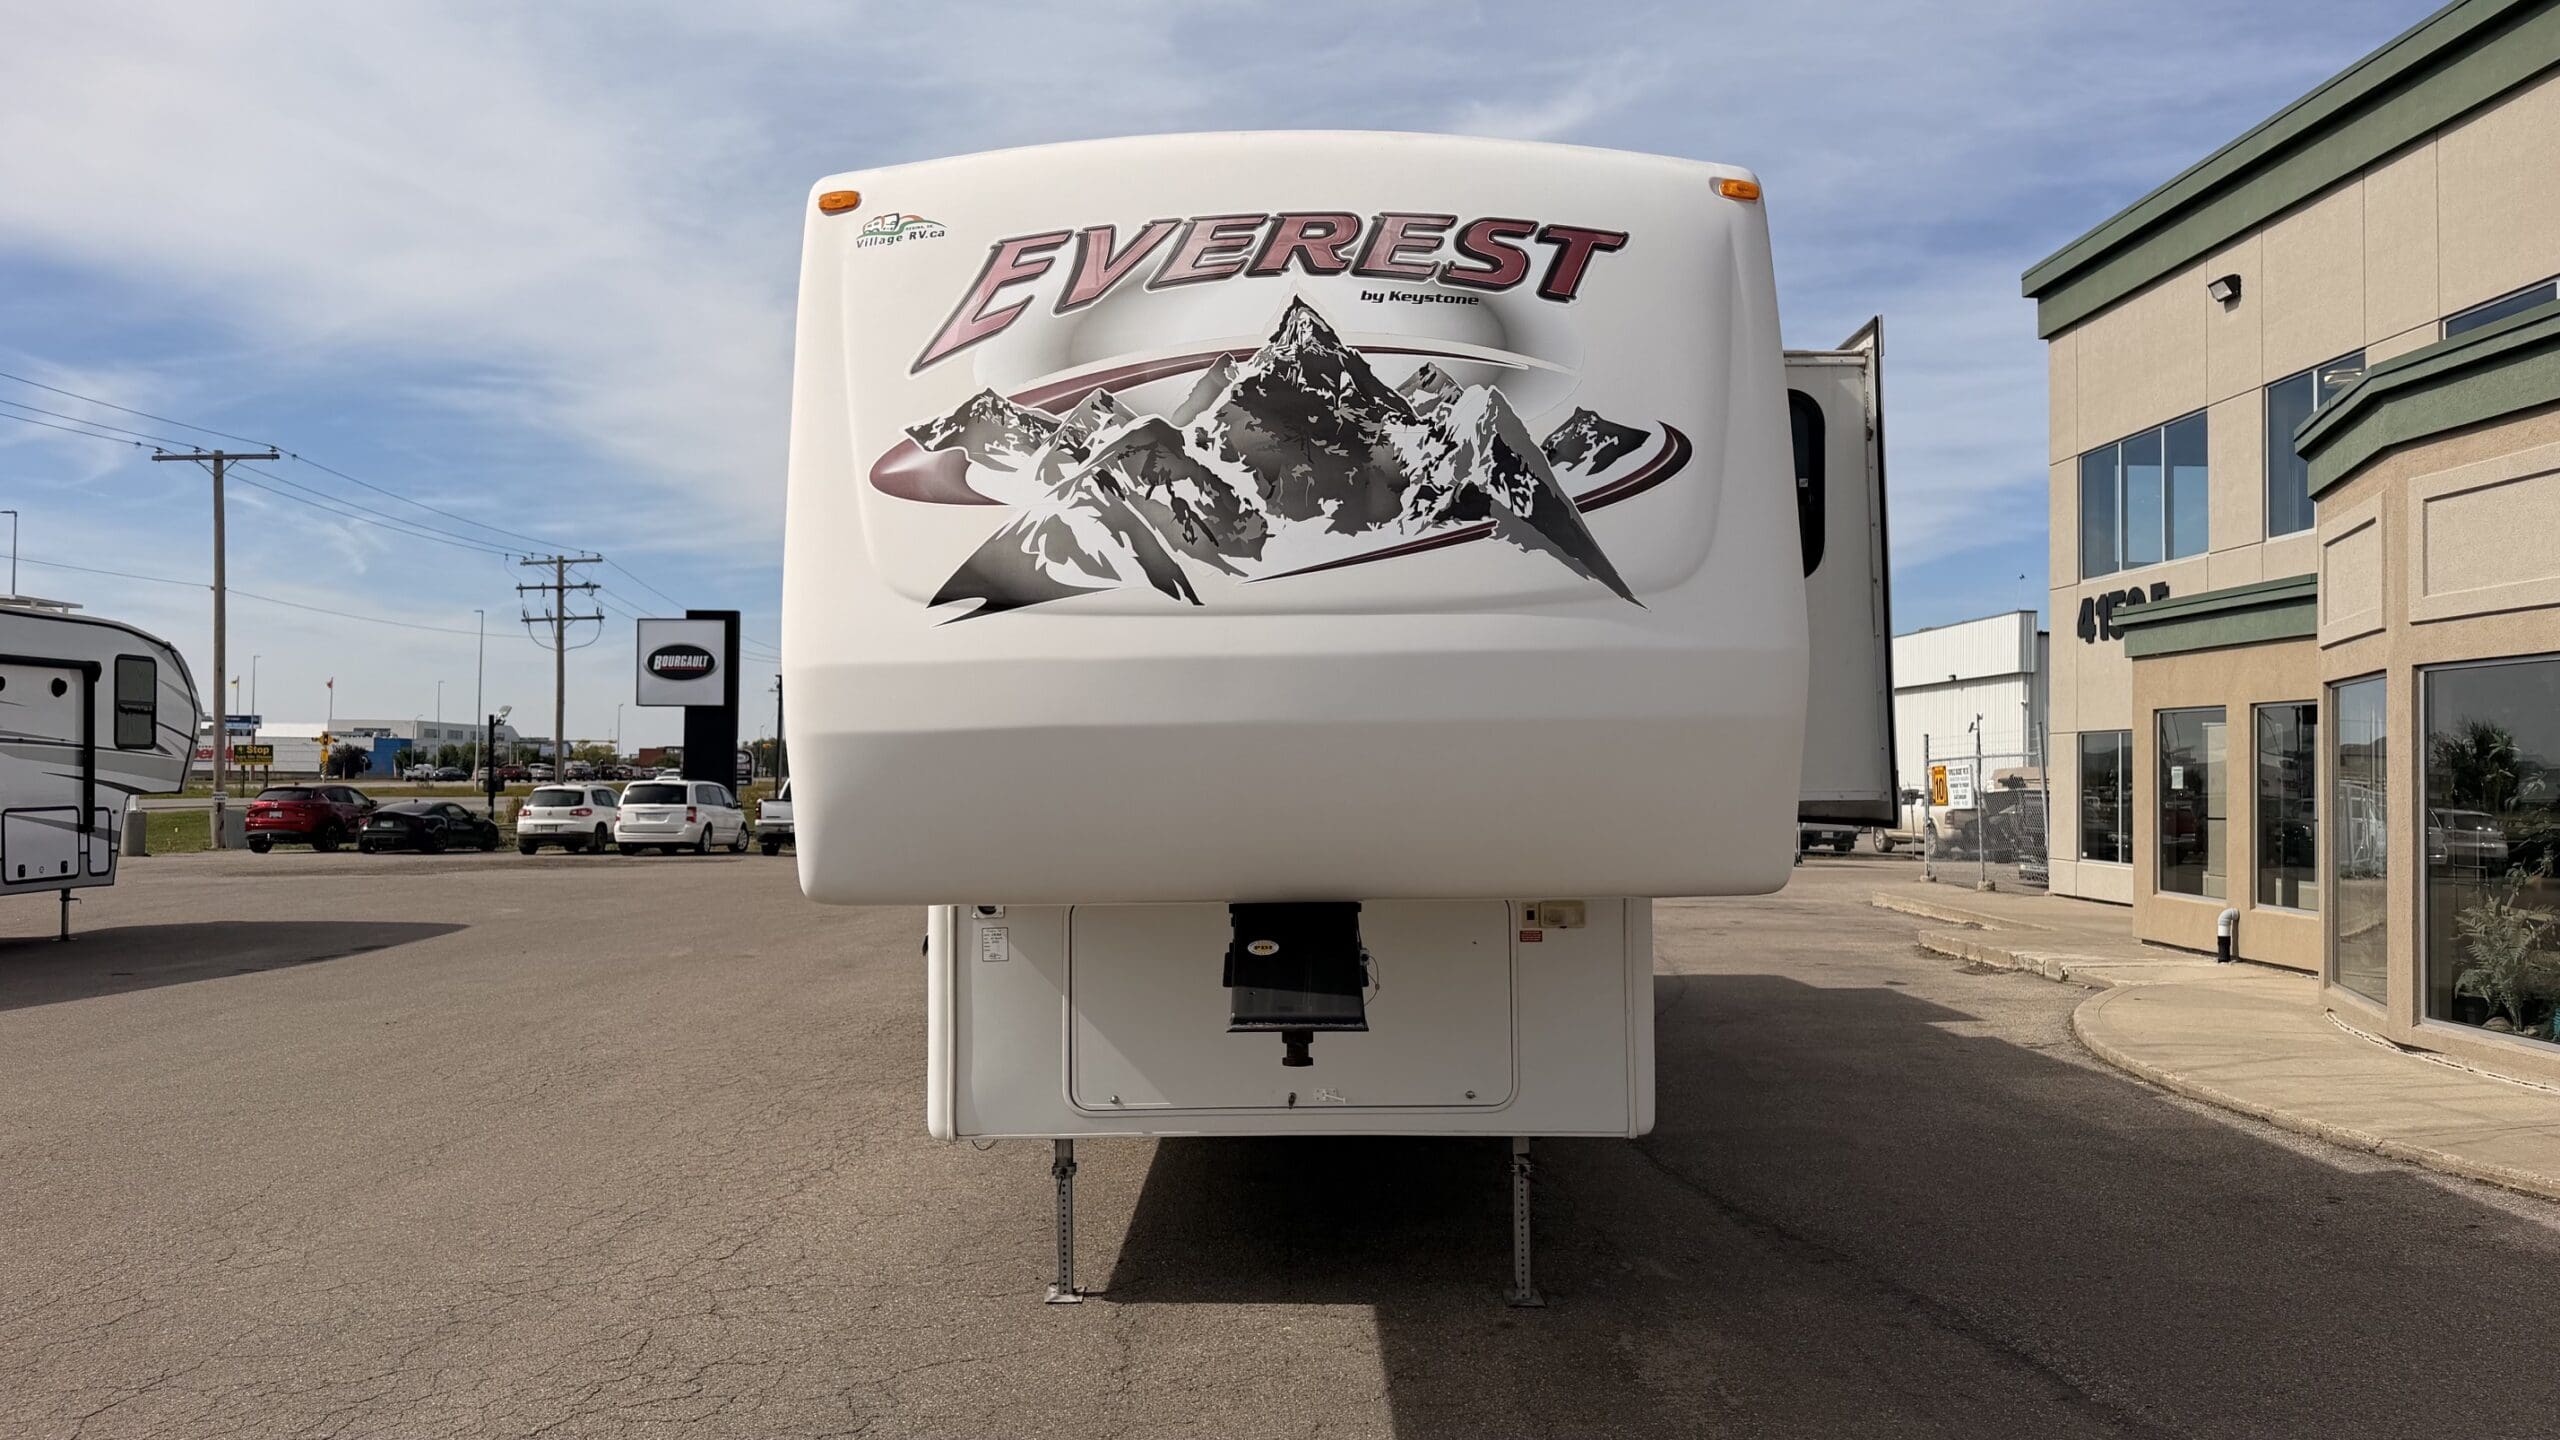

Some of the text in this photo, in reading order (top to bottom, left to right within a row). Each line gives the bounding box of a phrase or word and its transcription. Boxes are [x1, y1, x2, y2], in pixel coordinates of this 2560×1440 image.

[856, 230, 945, 248] Village RV.ca
[911, 211, 1629, 374] EVEREST
[1360, 290, 1480, 305] by Keystone
[653, 655, 709, 670] BOURGAULT
[246, 745, 270, 756] Stop
[1936, 778, 1944, 800] 10
